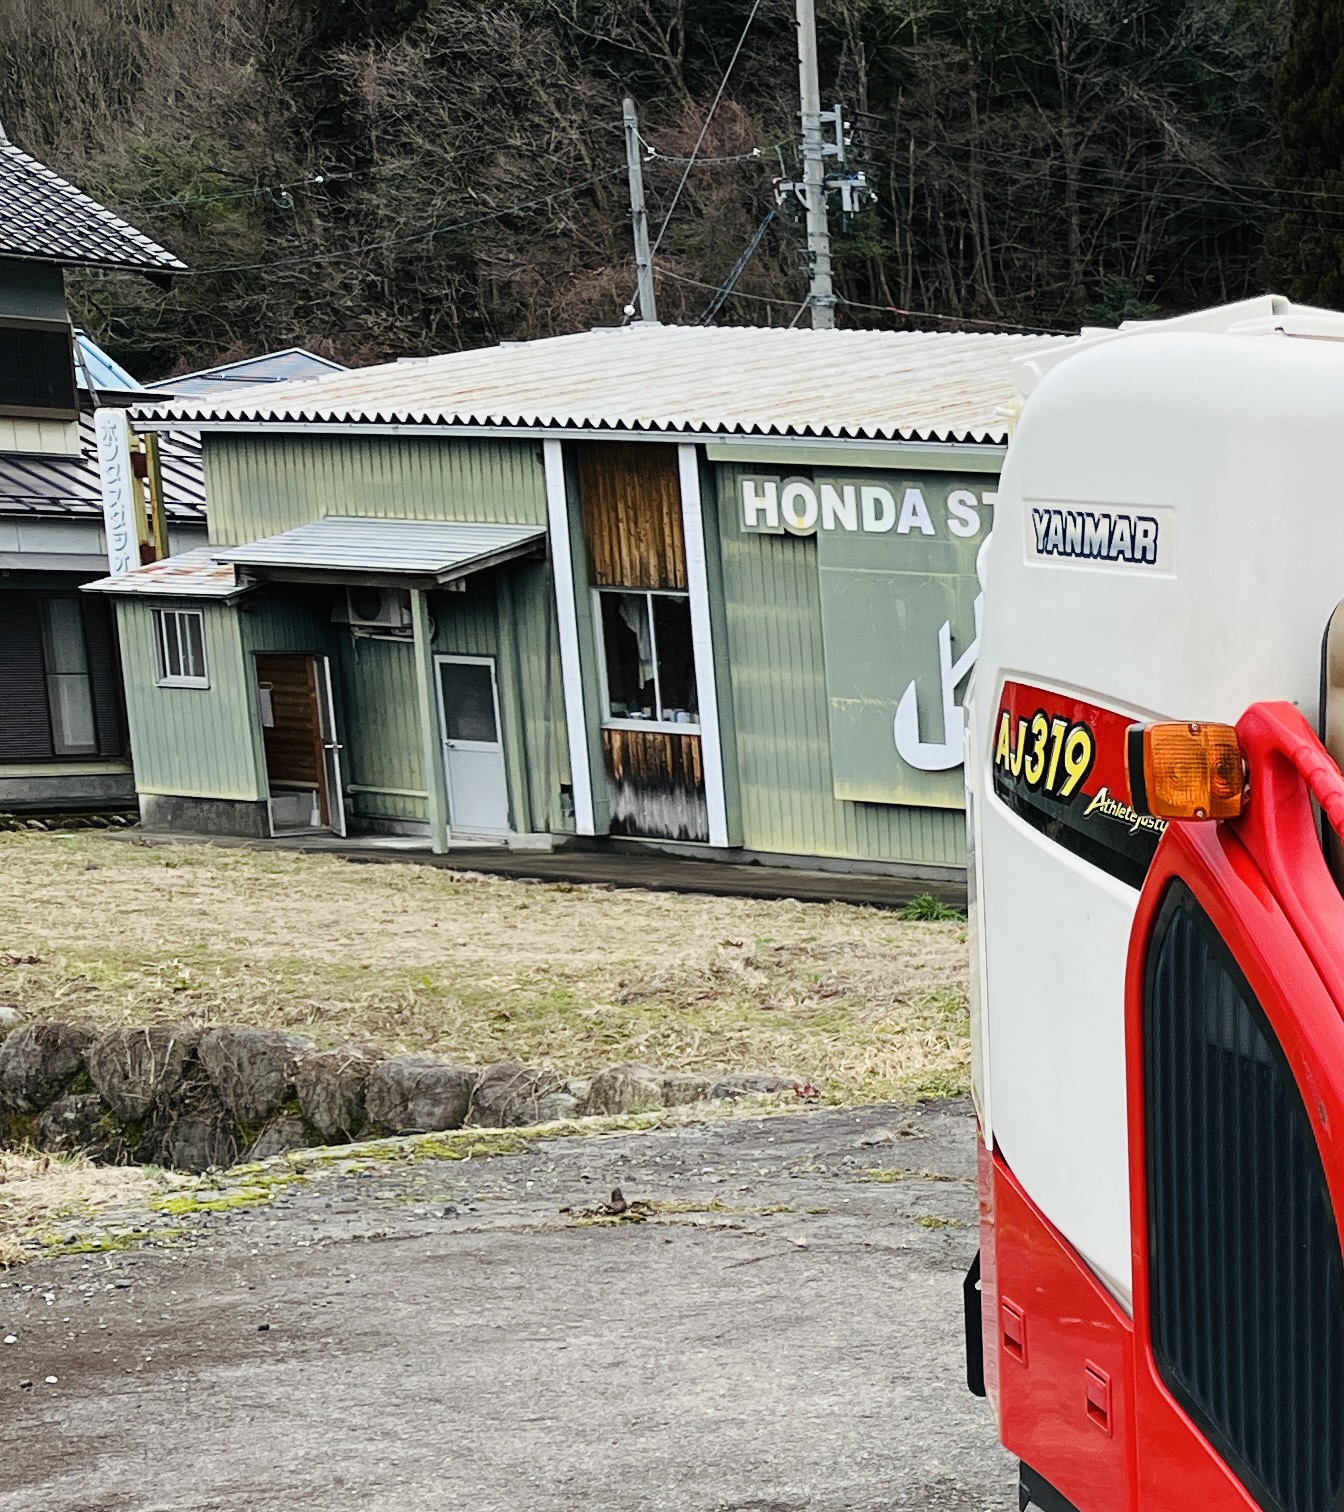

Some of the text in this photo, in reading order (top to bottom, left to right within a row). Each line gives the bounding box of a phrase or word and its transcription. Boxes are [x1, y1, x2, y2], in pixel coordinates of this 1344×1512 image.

[742, 480, 935, 536] HONDA
[1032, 508, 1158, 564] YANMAR
[996, 712, 1093, 798] AJ319
